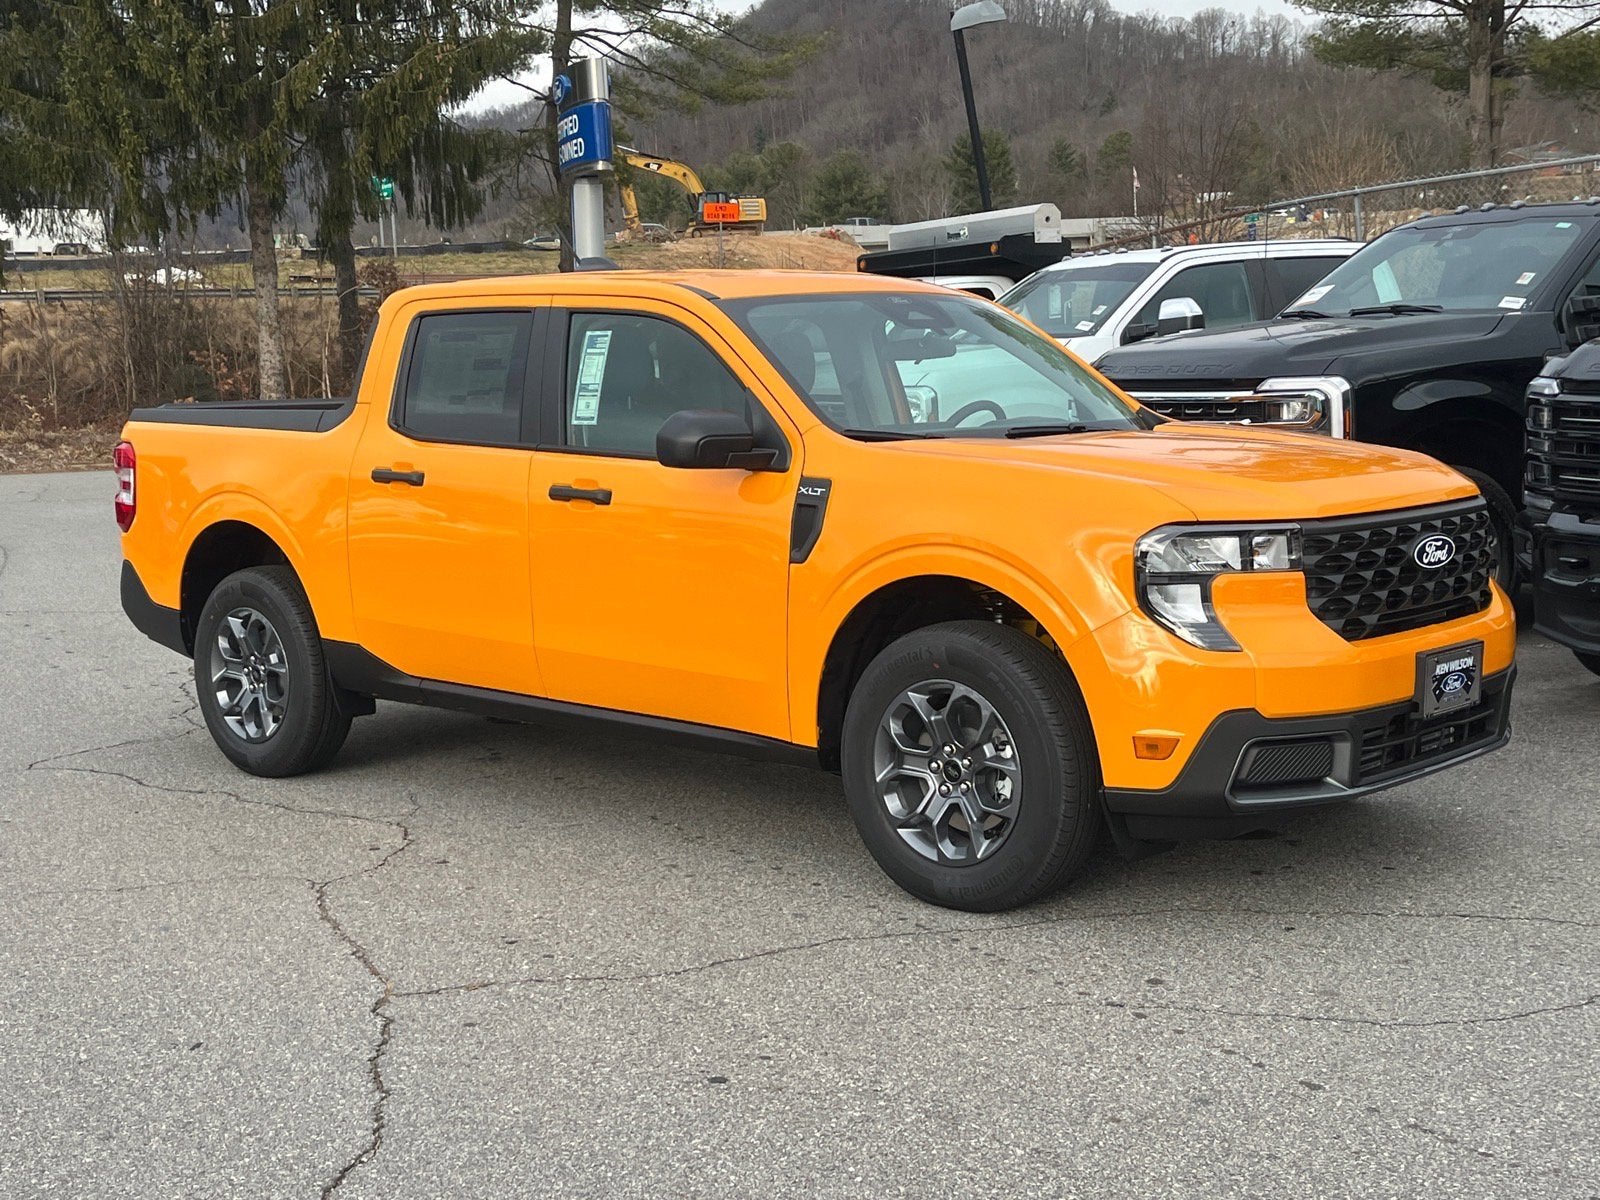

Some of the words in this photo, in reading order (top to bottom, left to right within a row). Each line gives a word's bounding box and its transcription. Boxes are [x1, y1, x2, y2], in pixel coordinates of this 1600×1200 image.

[1165, 363, 1237, 375] DUTY
[798, 486, 826, 496] XLT
[1422, 540, 1449, 564] Ford
[1435, 661, 1450, 675] KEN
[1450, 655, 1474, 673] WILSON
